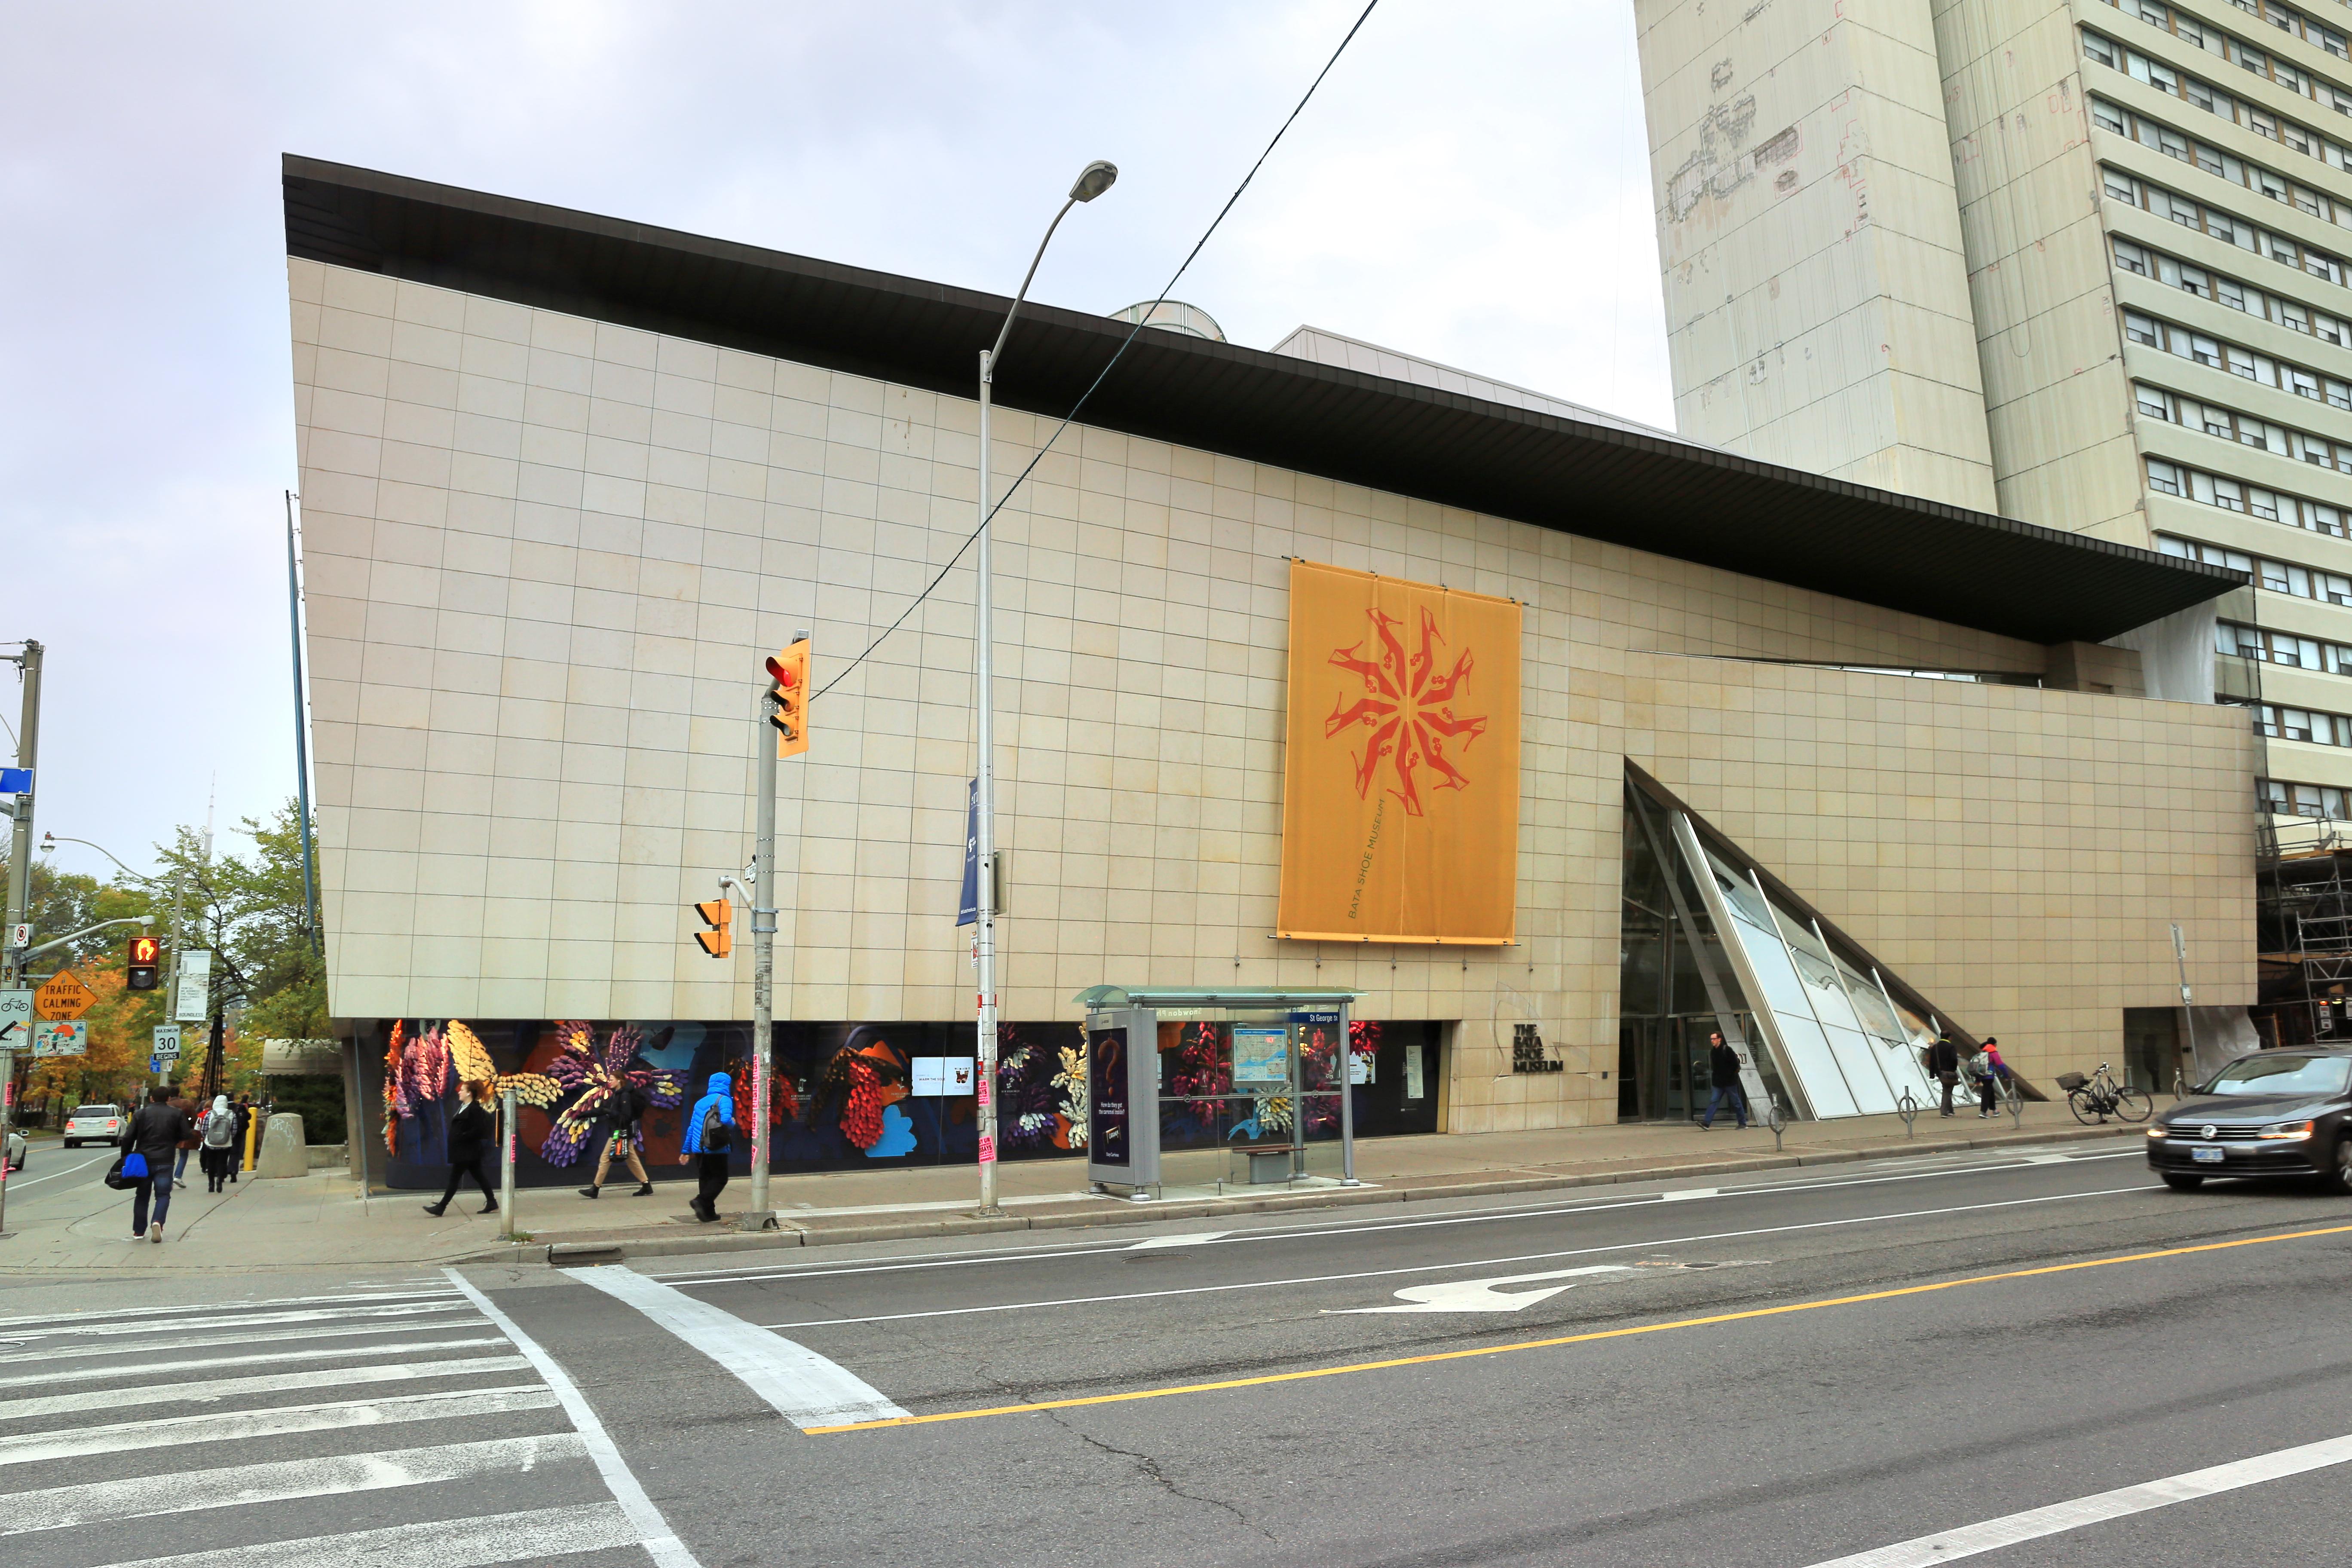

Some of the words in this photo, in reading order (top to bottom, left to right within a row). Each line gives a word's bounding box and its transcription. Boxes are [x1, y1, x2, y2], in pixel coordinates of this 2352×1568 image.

[1348, 889, 1362, 919] BATA
[1358, 851, 1373, 885] SHOE
[1368, 799, 1385, 849] MUSEUM
[45, 985, 81, 995] TRAFFIC
[43, 998, 81, 1008] CALMING
[50, 1011, 72, 1020] ZONE
[1316, 1014, 1332, 1023] George
[1514, 1024, 1537, 1036] THE
[158, 1037, 176, 1050] 30
[1514, 1036, 1543, 1048] BATA
[1513, 1048, 1544, 1060] SHOE
[1513, 1060, 1563, 1072] MUSEUM
